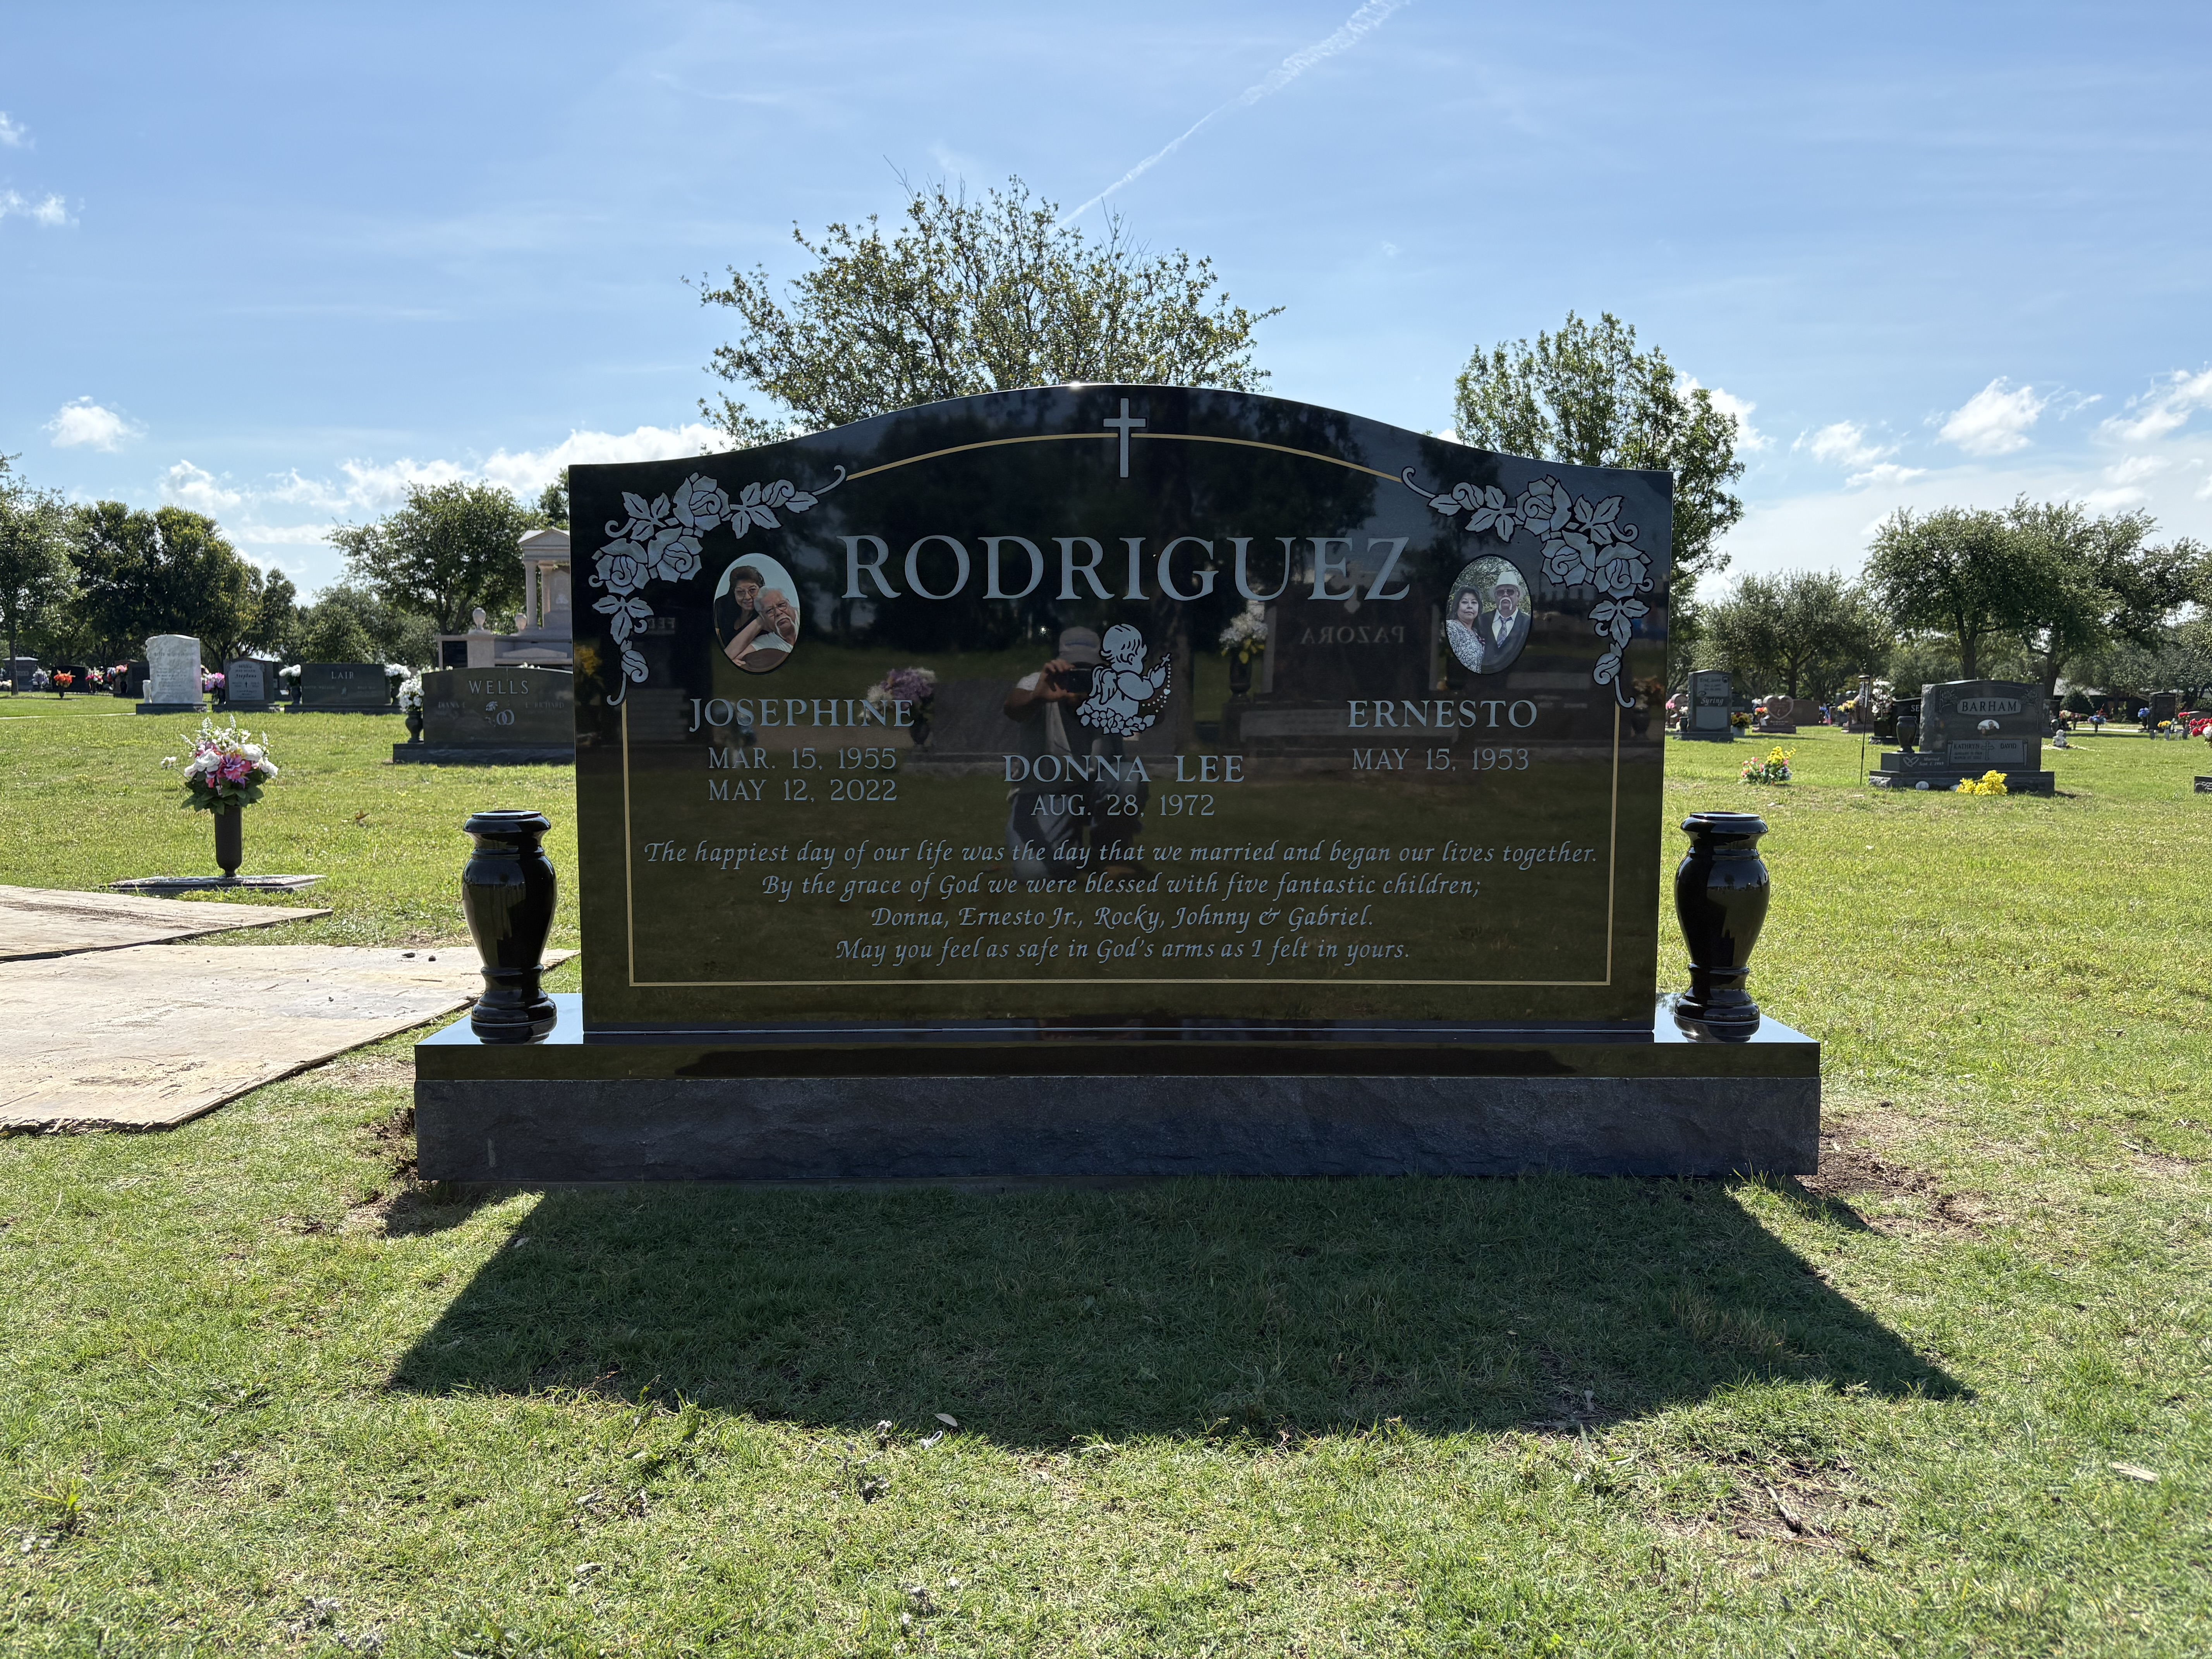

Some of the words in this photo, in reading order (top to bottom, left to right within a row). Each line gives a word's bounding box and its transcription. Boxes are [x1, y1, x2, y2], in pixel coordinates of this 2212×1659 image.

[836, 535, 1411, 601] RODRIGUEZ
[331, 671, 354, 679] LAIR
[468, 680, 529, 694] WELLS
[1347, 700, 1538, 728] ERNESTO
[1700, 697, 1724, 706] Syring
[1961, 701, 2017, 712] BARHAM
[689, 698, 915, 733] JOSEPHINE
[708, 747, 776, 769] MAR.
[792, 747, 823, 771] 15,
[838, 747, 897, 769] 1955
[1003, 755, 1152, 783] DONNA
[1175, 755, 1245, 783] LEE
[1352, 748, 1410, 770] MAY
[1426, 748, 1456, 772] 15,
[1472, 748, 1530, 771] 1953
[708, 779, 767, 801] MAY
[783, 779, 815, 803] 12,
[830, 779, 898, 801] 2022
[1030, 794, 1092, 816] AUG.
[1106, 794, 1144, 818] 28,
[1159, 794, 1216, 816] 1972
[643, 841, 687, 862] The
[695, 840, 789, 871] happiest
[797, 840, 836, 870] day
[844, 839, 869, 870] of
[873, 848, 911, 862] our
[917, 840, 953, 870] life
[962, 847, 1005, 862] was
[1012, 840, 1046, 862] the
[1053, 840, 1091, 870] day
[1099, 840, 1145, 862] that
[1153, 847, 1183, 862] we
[1190, 840, 1277, 862] married
[1283, 841, 1323, 862] and
[1329, 840, 1391, 870] began
[1399, 847, 1436, 862] our
[1442, 840, 1494, 862] lives
[1503, 841, 1597, 871] together.
[762, 872, 793, 903] By
[802, 871, 836, 894] the
[839, 879, 902, 903] grace
[910, 871, 933, 903] of
[939, 871, 981, 894] God
[988, 879, 1018, 894] we
[1027, 879, 1078, 894] were
[1084, 871, 1162, 894] blessed
[1167, 871, 1219, 894] with
[1222, 871, 1269, 902] five
[1273, 871, 1376, 902] fantastic
[1382, 872, 1481, 897] children;
[871, 907, 950, 929] Donna,
[958, 907, 1045, 927] Ernesto
[1048, 907, 1084, 929] Jr.,
[1094, 905, 1165, 933] Rocky,
[1172, 904, 1251, 934] Johnny
[1258, 908, 1281, 926] &
[1288, 905, 1374, 932] Gabriel.
[836, 938, 887, 967] May
[893, 944, 933, 967] you
[936, 936, 980, 966] feel
[985, 944, 1009, 958] as
[1016, 936, 1060, 966] safe
[1068, 939, 1089, 958] in
[1096, 937, 1154, 963] God's
[1161, 943, 1215, 958] arms
[1220, 943, 1244, 958] as
[1251, 939, 1263, 958] I
[1266, 936, 1308, 966] felt
[1317, 939, 1339, 958] in
[1343, 944, 1410, 967] yours.
